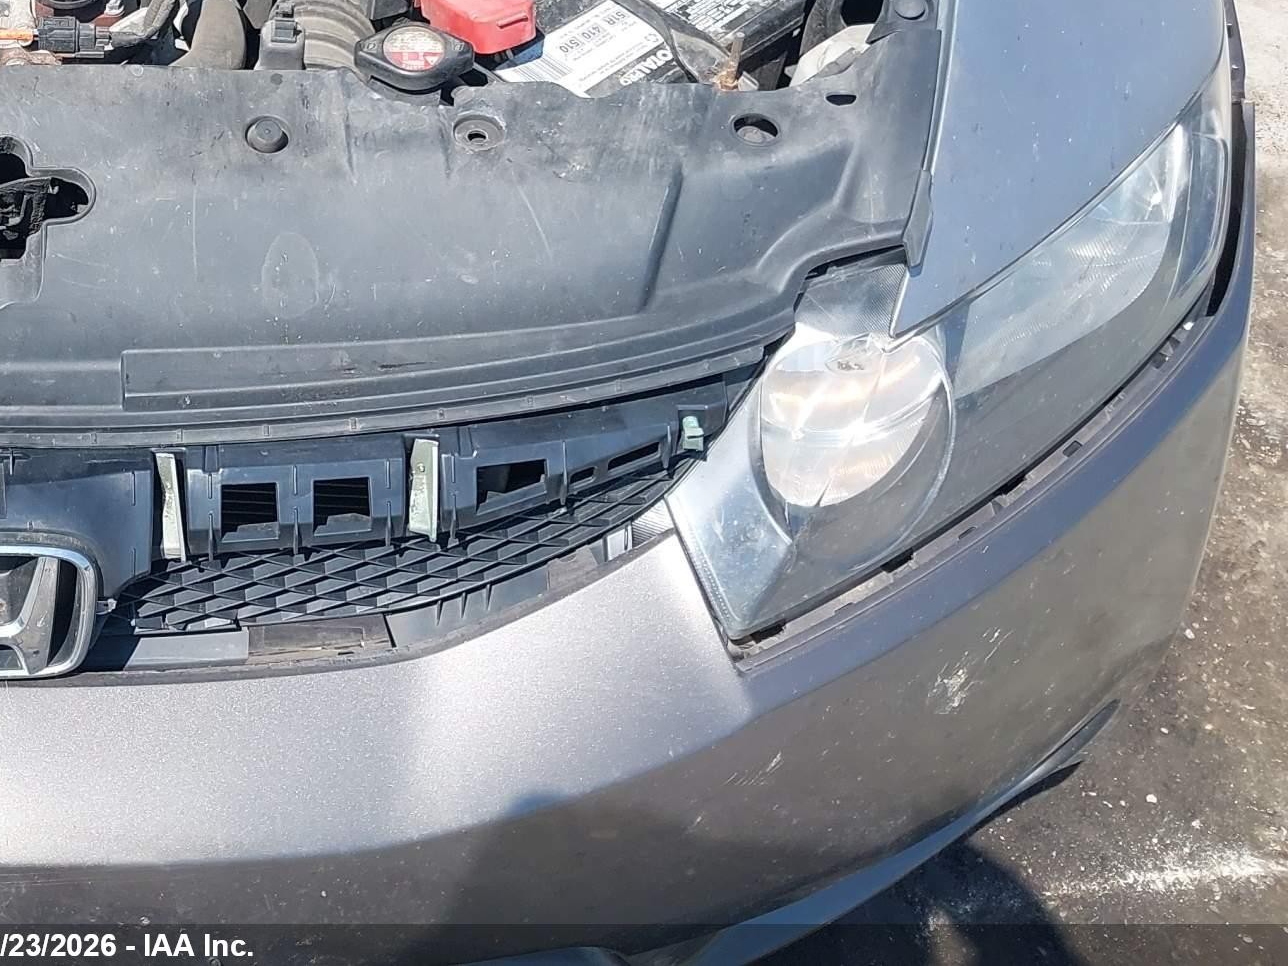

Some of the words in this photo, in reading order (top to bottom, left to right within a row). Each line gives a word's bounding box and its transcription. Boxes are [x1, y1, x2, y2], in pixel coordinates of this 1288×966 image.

[580, 25, 601, 40] 410
[559, 39, 580, 53] 510
[619, 49, 673, 86] OTALPRO
